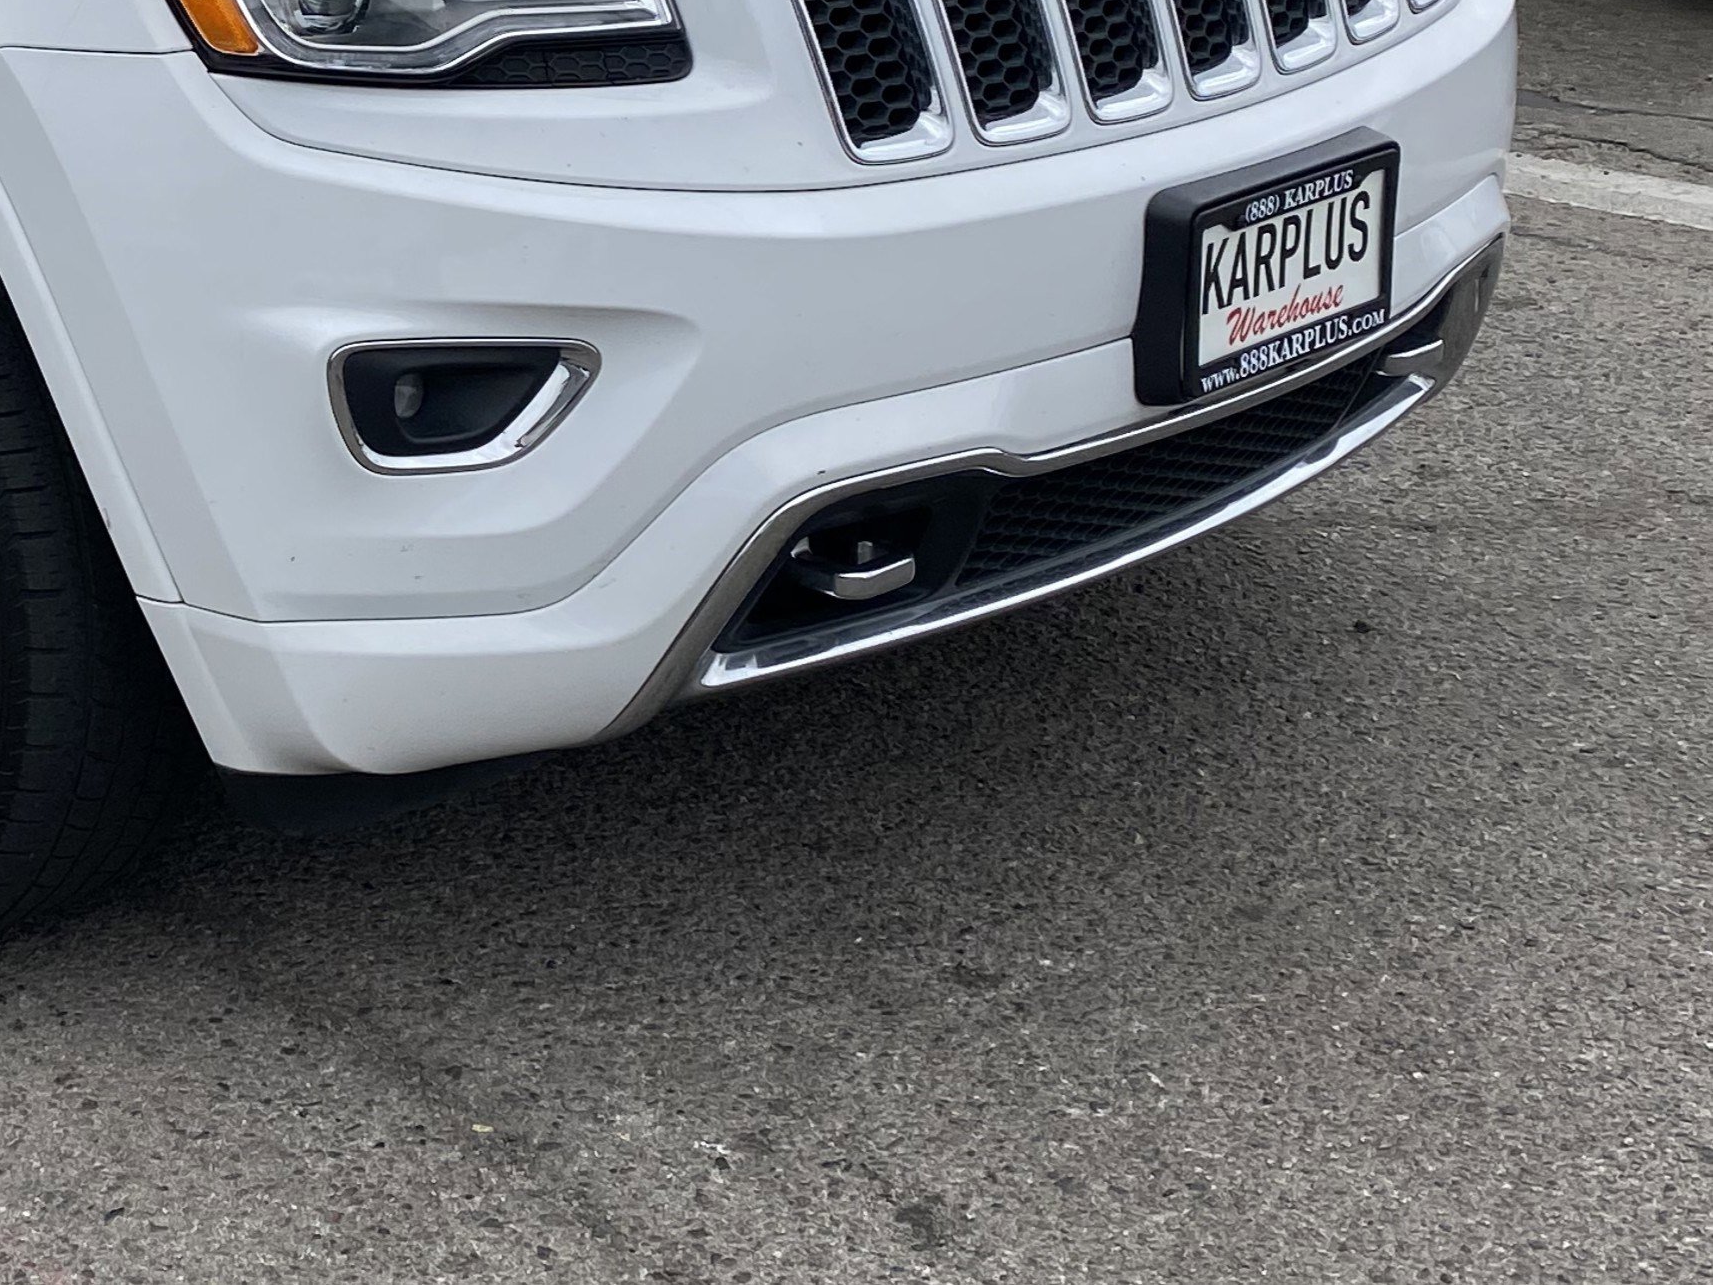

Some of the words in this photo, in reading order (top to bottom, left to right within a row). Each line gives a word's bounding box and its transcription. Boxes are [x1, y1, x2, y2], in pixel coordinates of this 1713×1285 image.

[1244, 195, 1280, 223] (888)
[1283, 169, 1354, 210] KARPLUS
[1201, 190, 1371, 316] KARPLUS
[1226, 283, 1344, 346] Warehouse
